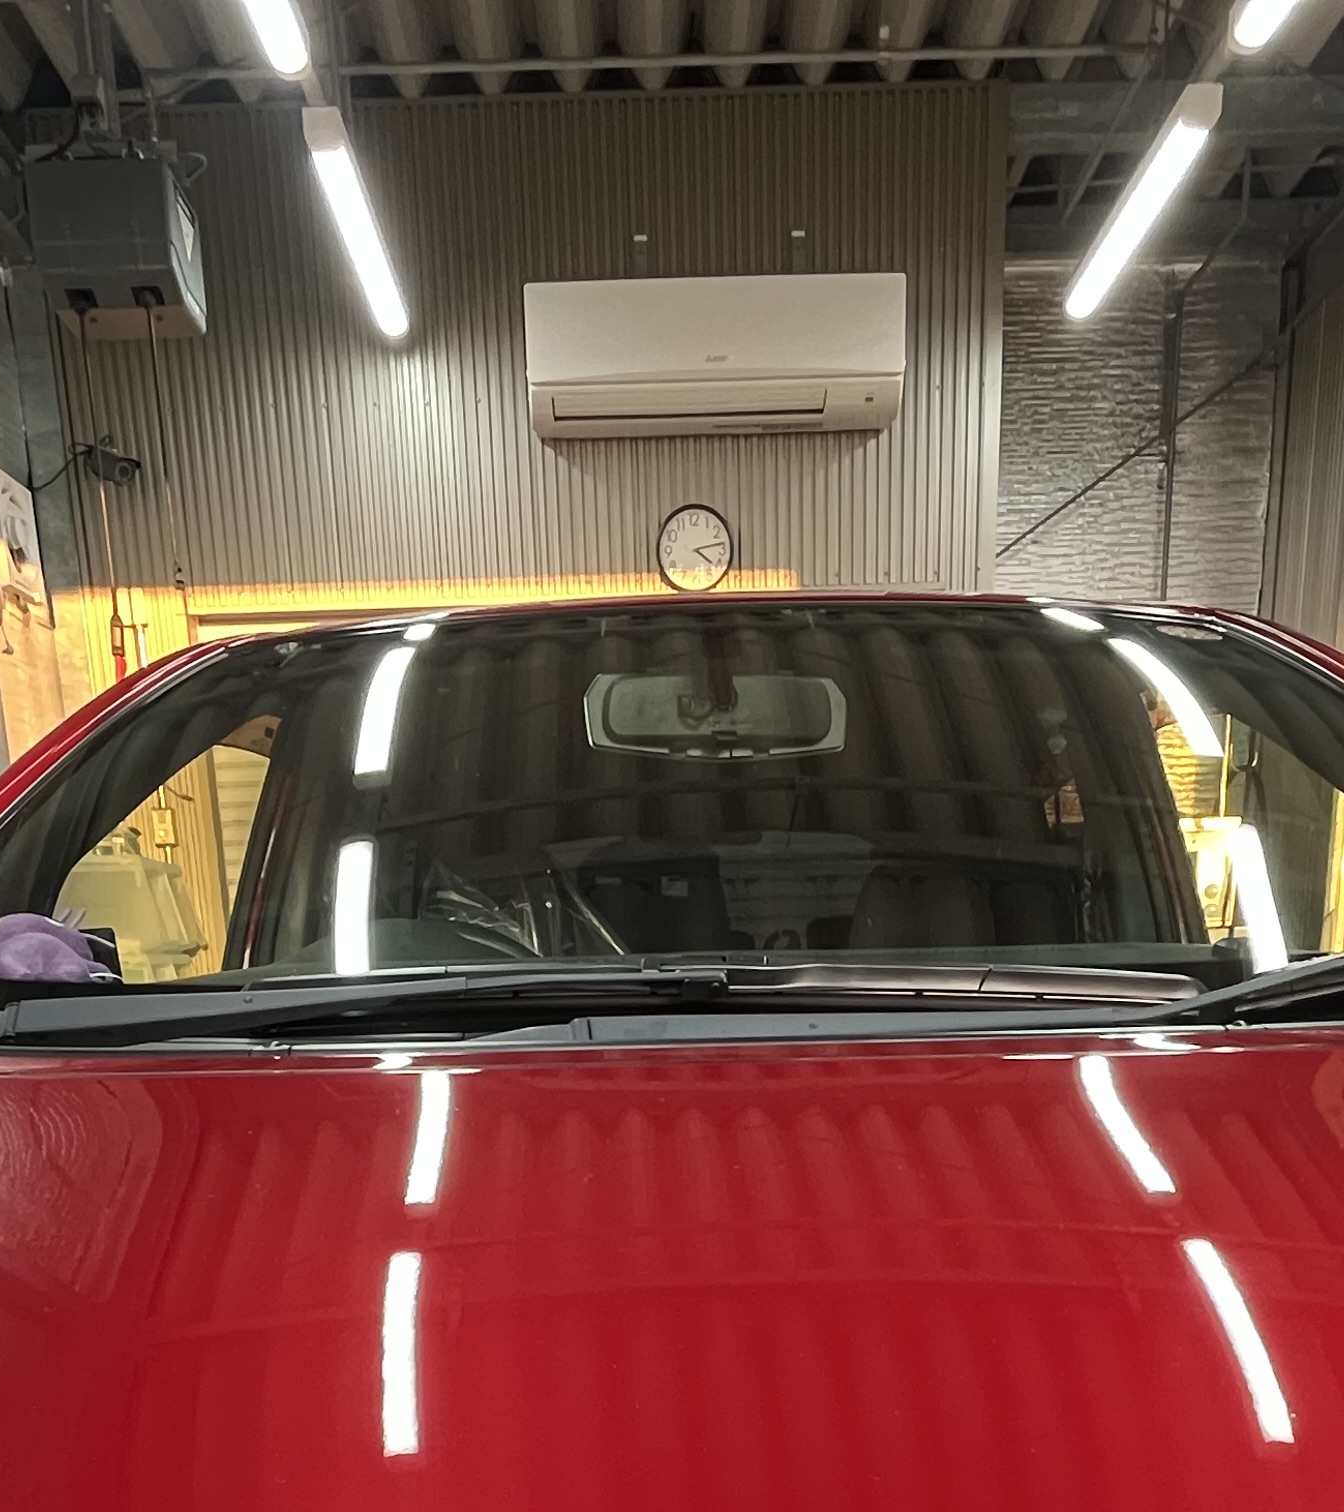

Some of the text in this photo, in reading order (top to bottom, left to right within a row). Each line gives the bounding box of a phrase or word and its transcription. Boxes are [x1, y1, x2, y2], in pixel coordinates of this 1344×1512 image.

[676, 518, 685, 532] 11
[688, 513, 700, 527] 12
[705, 516, 709, 529] 1
[666, 529, 677, 543] 10
[713, 525, 721, 539] 2
[665, 545, 672, 558] 9
[719, 542, 726, 556] 3
